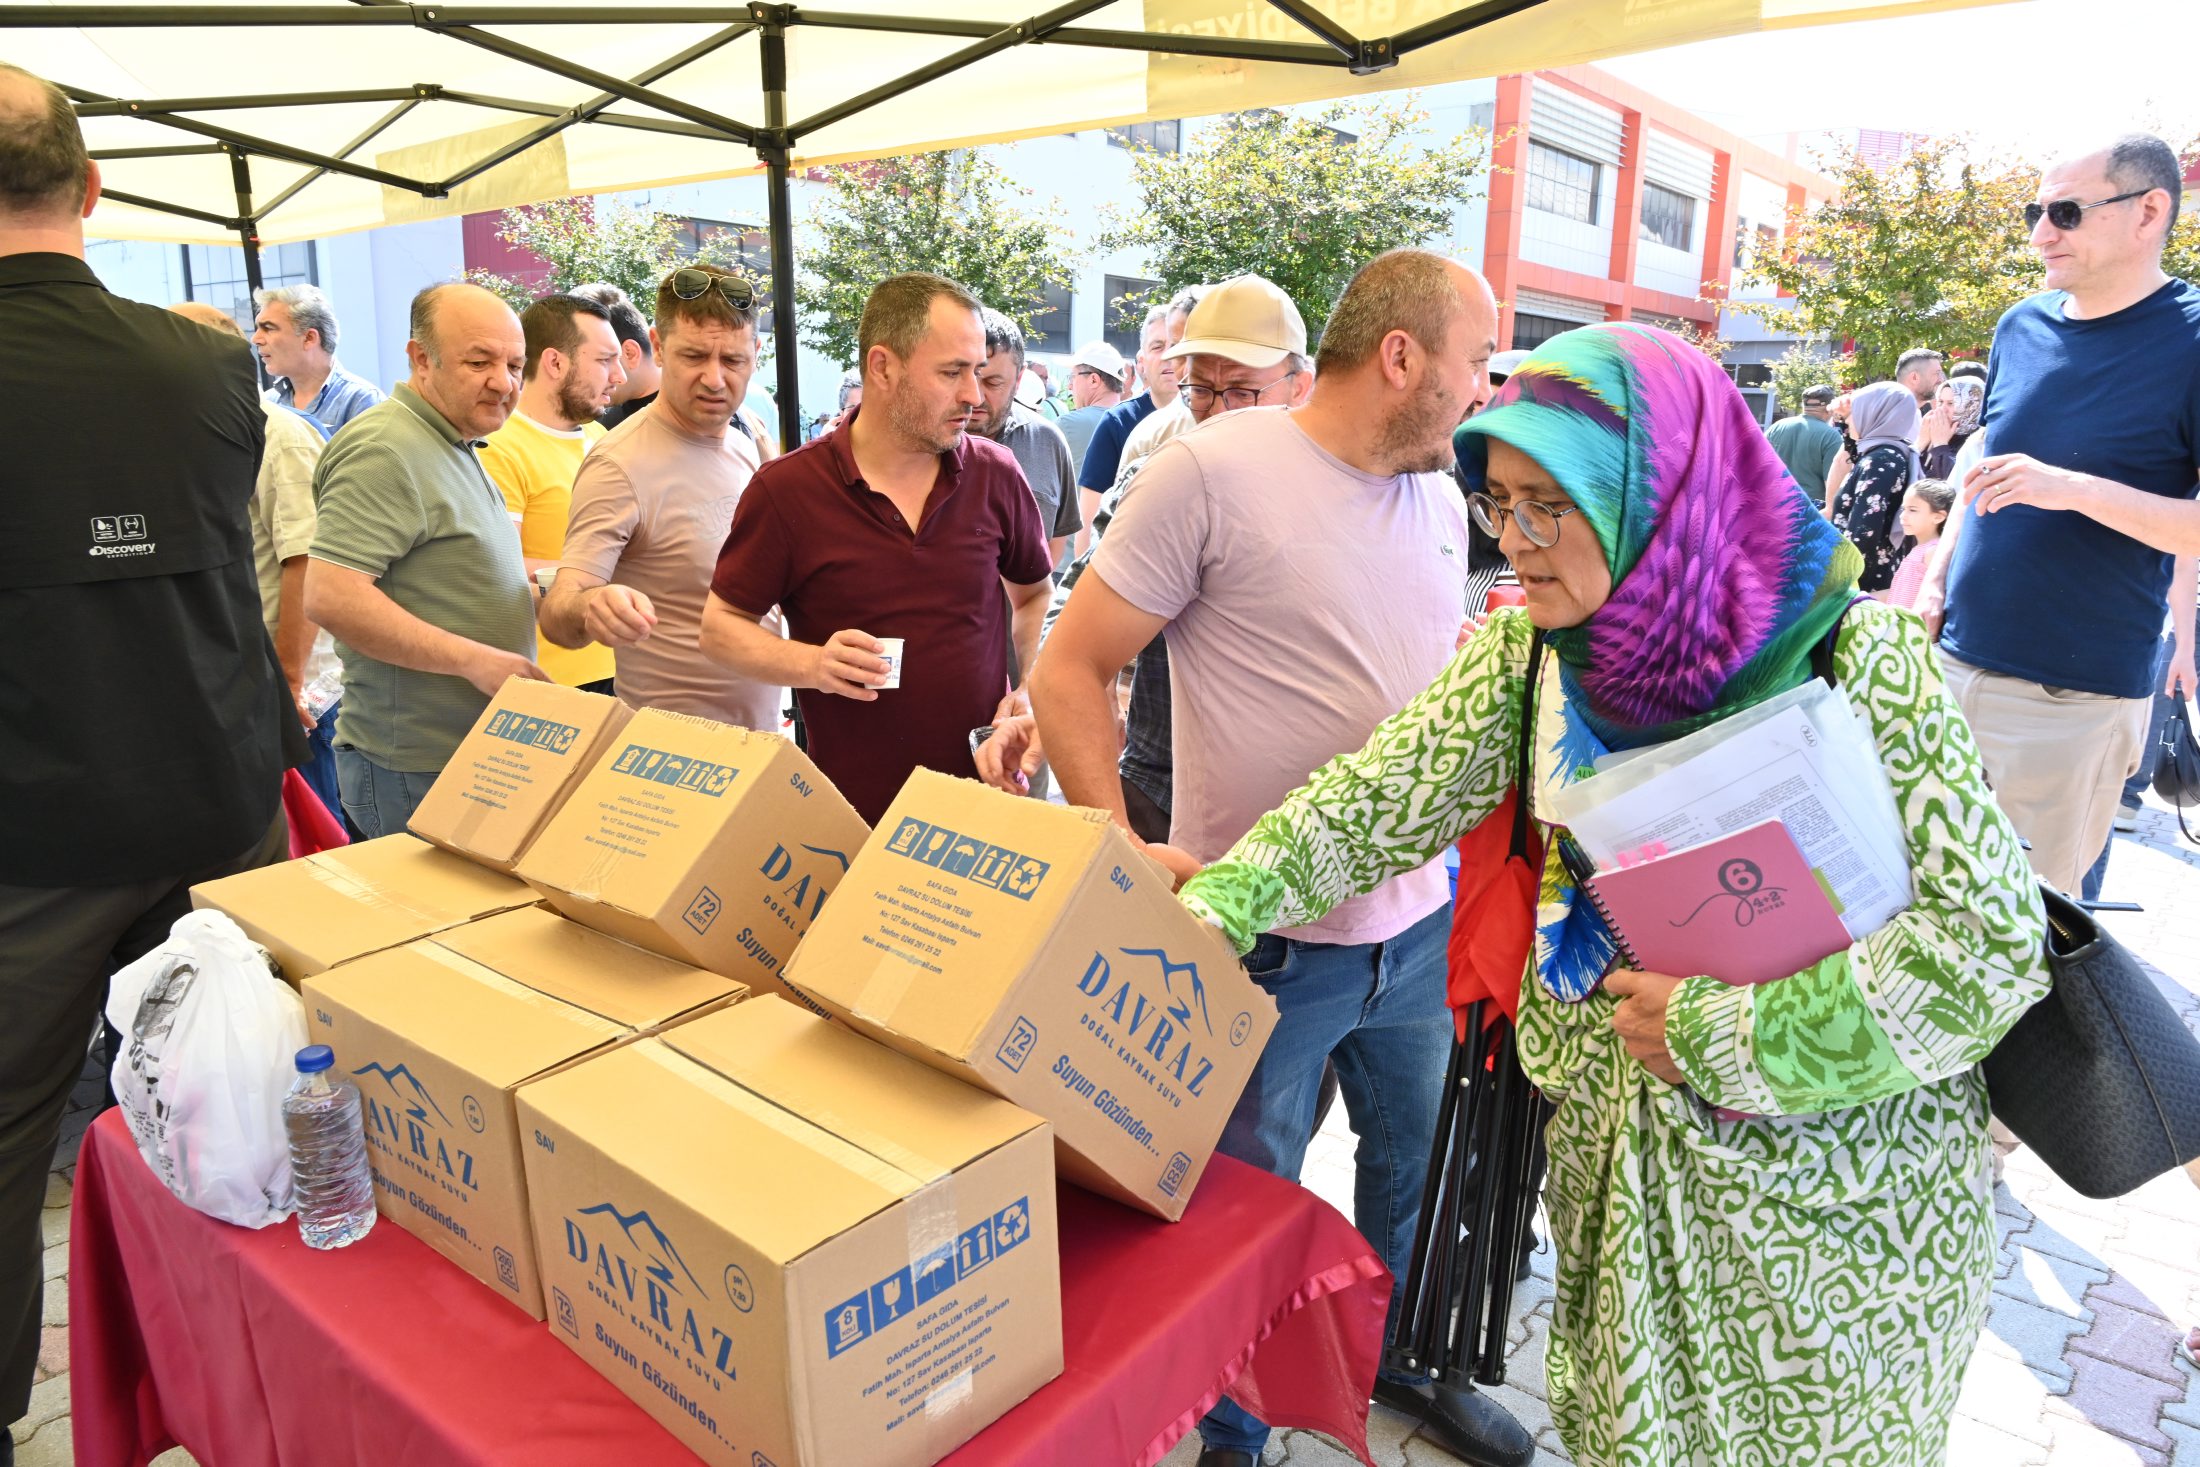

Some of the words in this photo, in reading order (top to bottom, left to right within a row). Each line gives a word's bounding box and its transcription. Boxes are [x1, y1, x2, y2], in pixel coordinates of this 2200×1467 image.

[89, 543, 156, 556] Discovery
[790, 772, 814, 798] SAV
[759, 842, 830, 922] DAV
[1110, 866, 1134, 894] SAV
[1725, 862, 1758, 891] 6
[690, 910, 706, 926] ADET
[698, 895, 716, 917] 72
[763, 894, 796, 930] DOĞAL
[736, 928, 778, 970] Suyun
[316, 1008, 332, 1028] SAV
[1076, 950, 1214, 1098] DAVRAZ
[1004, 1046, 1022, 1062] ADET
[1012, 1026, 1032, 1052] 72
[1080, 1013, 1115, 1050] DOĞAL
[1117, 1047, 1157, 1086] KAYNAK
[1156, 1081, 1182, 1109] SUYU
[1052, 1055, 1096, 1100] Suyun
[1094, 1089, 1160, 1157] Gözünden...
[367, 1096, 479, 1191] AVRAZ
[534, 1128, 555, 1154] SAV
[1167, 1169, 1180, 1184] CC
[1172, 1156, 1187, 1174] 200
[440, 1180, 468, 1203] SUYU
[371, 1166, 406, 1200] Suyun
[409, 1190, 482, 1251] Gözünden...
[557, 1295, 572, 1320] 72
[562, 1216, 737, 1382] DAVRAZ
[844, 1310, 853, 1326] 8
[916, 1312, 938, 1330] SAFA
[939, 1299, 958, 1316] GIDA
[588, 1279, 626, 1318] DOĞAL
[630, 1312, 681, 1361] KAYNAK
[686, 1356, 722, 1393] SUYU
[886, 1339, 920, 1365] DAVRAZ
[922, 1331, 933, 1343] SU
[934, 1312, 963, 1336] DOLUM
[863, 1381, 883, 1398] Fatih
[885, 1368, 904, 1383] Mah.
[906, 1350, 932, 1370] Isparta
[932, 1331, 961, 1353] Antalya
[886, 1386, 900, 1399] No:
[903, 1375, 916, 1388] 127
[917, 1365, 932, 1378] Sav
[968, 1326, 992, 1346] Isparta
[900, 1383, 930, 1406] Telefon:
[964, 1353, 974, 1364] 25
[974, 1346, 984, 1358] 22
[594, 1322, 638, 1370] Suyun
[642, 1359, 737, 1452] Gözünden...
[886, 1416, 906, 1432] Mail:
